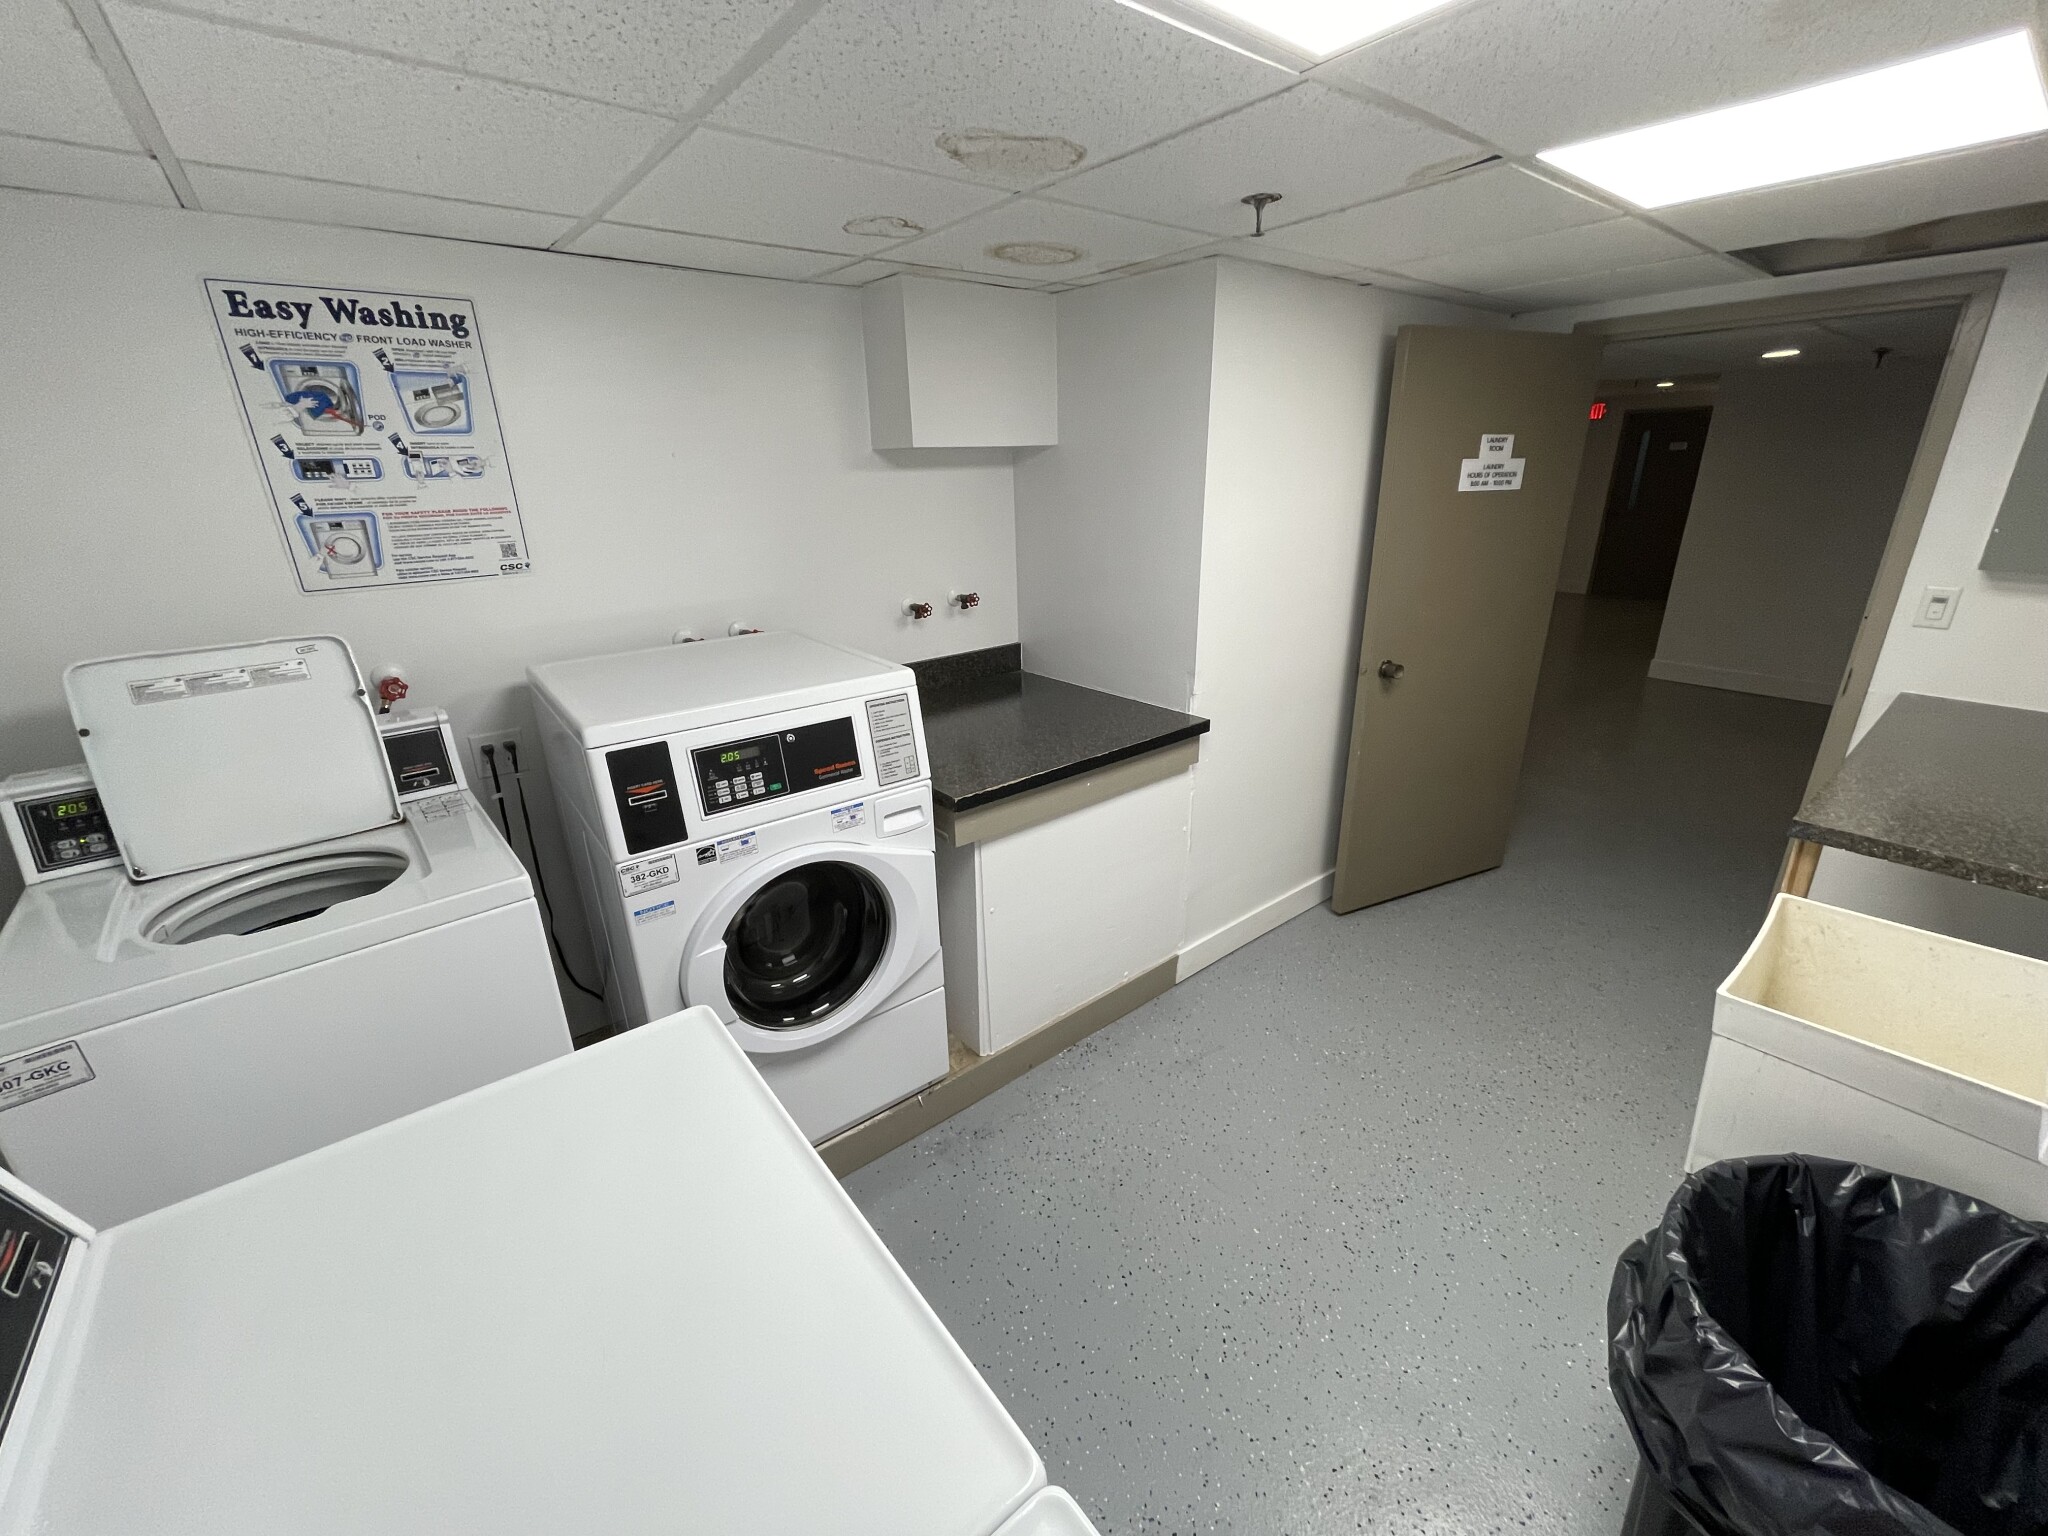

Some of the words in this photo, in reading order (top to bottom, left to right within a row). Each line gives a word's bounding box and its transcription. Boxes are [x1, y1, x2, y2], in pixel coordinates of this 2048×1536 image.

[222, 290, 312, 329] Easy
[319, 296, 470, 339] Washing
[234, 328, 337, 342] HIGH-EFFICIENCY
[356, 334, 392, 345] FRONT
[397, 338, 426, 347] LOAD
[428, 339, 472, 349] WASHER
[500, 562, 523, 571] CSC
[630, 866, 669, 883] 382-GKD
[0, 1061, 71, 1093] 07-GKC
